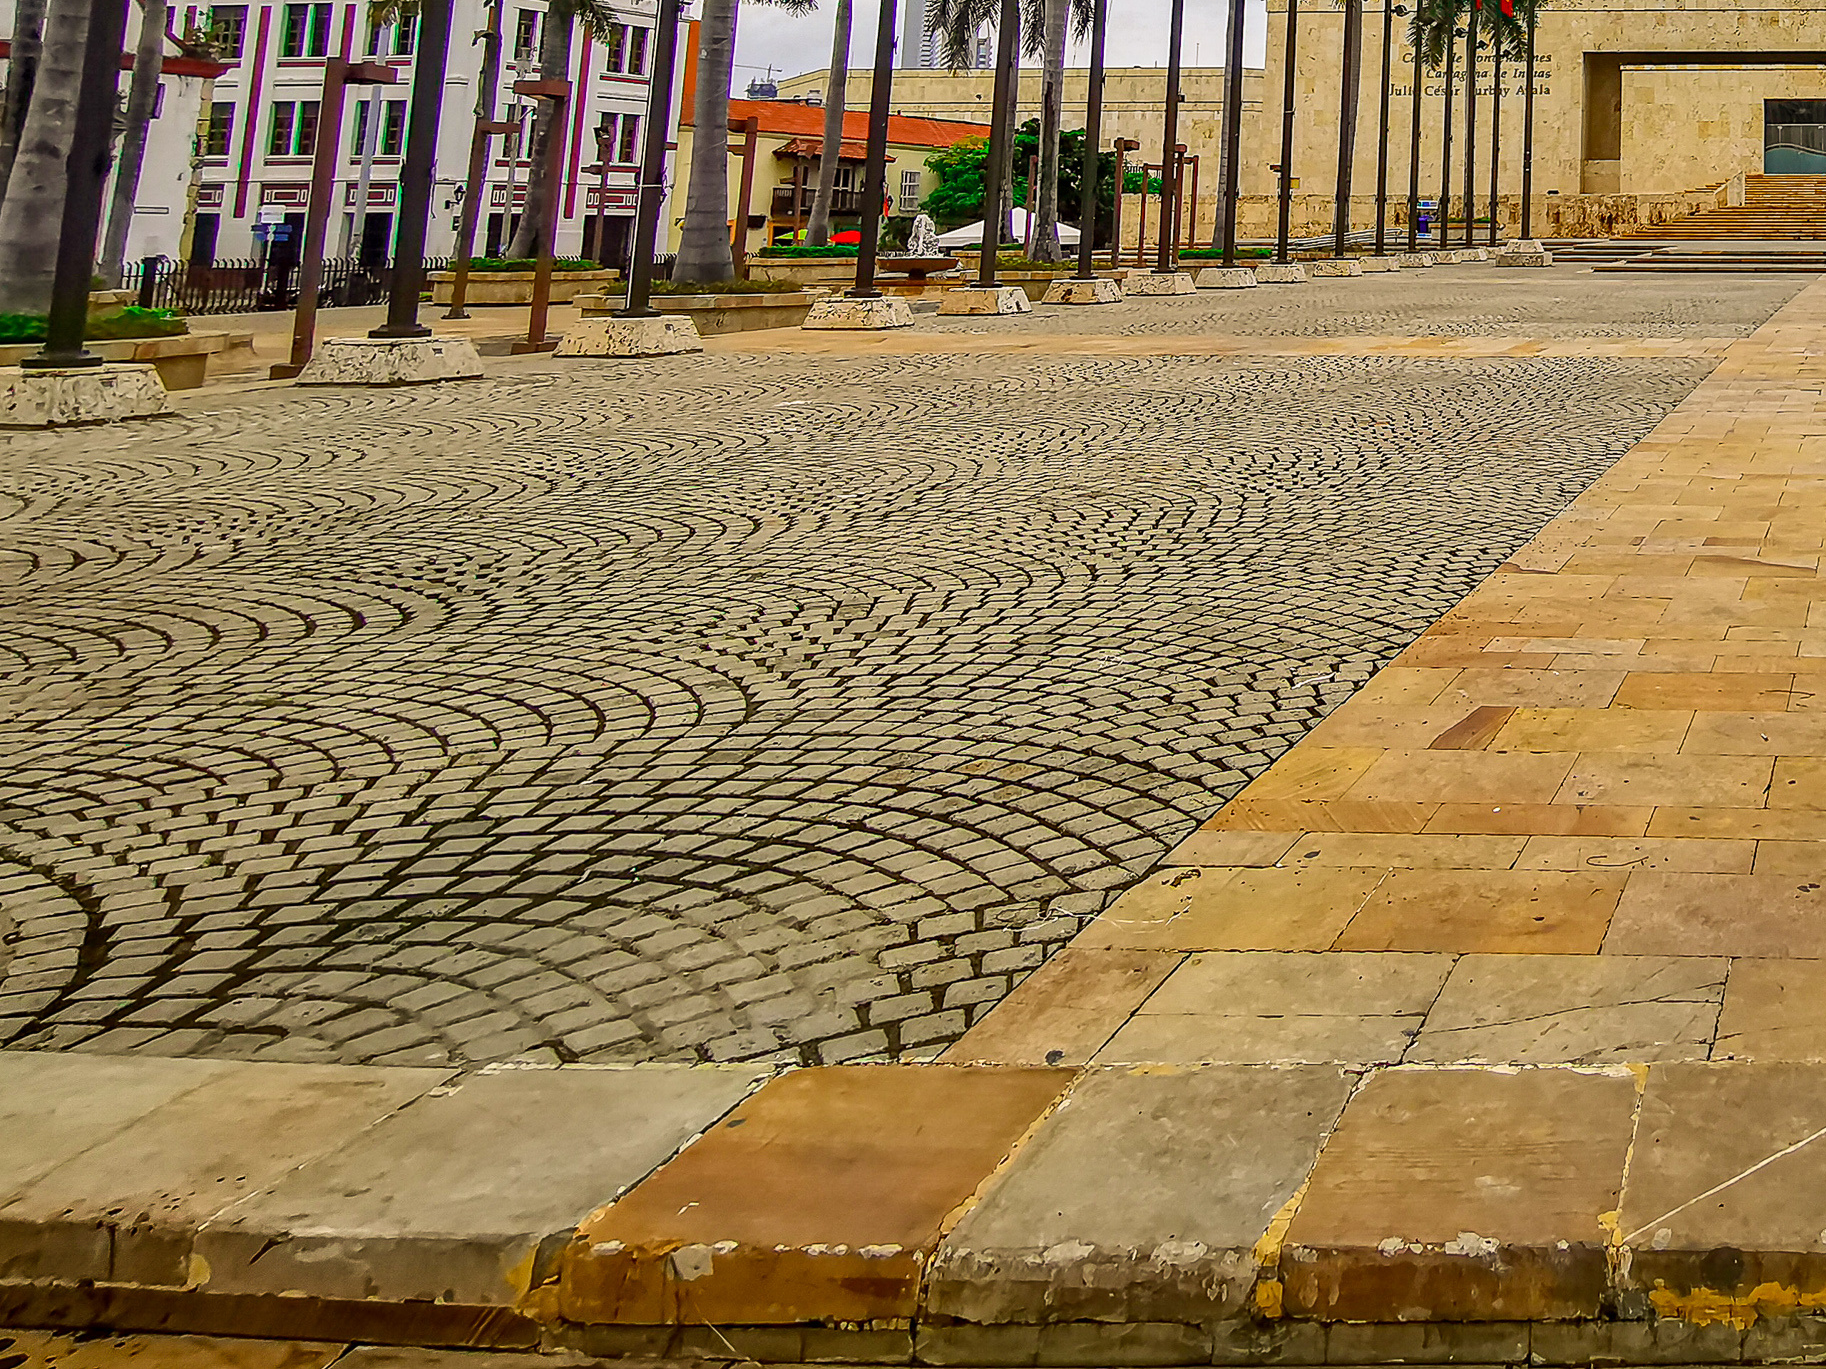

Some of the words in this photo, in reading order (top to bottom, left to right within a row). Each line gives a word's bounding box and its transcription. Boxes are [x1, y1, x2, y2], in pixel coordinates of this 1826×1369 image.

[1426, 69, 1489, 82] Caragna
[1513, 68, 1552, 79] Inias
[1389, 83, 1419, 96] Juli
[1424, 85, 1460, 96] Césr
[1468, 85, 1510, 98] urby
[1516, 83, 1551, 96] Aala
